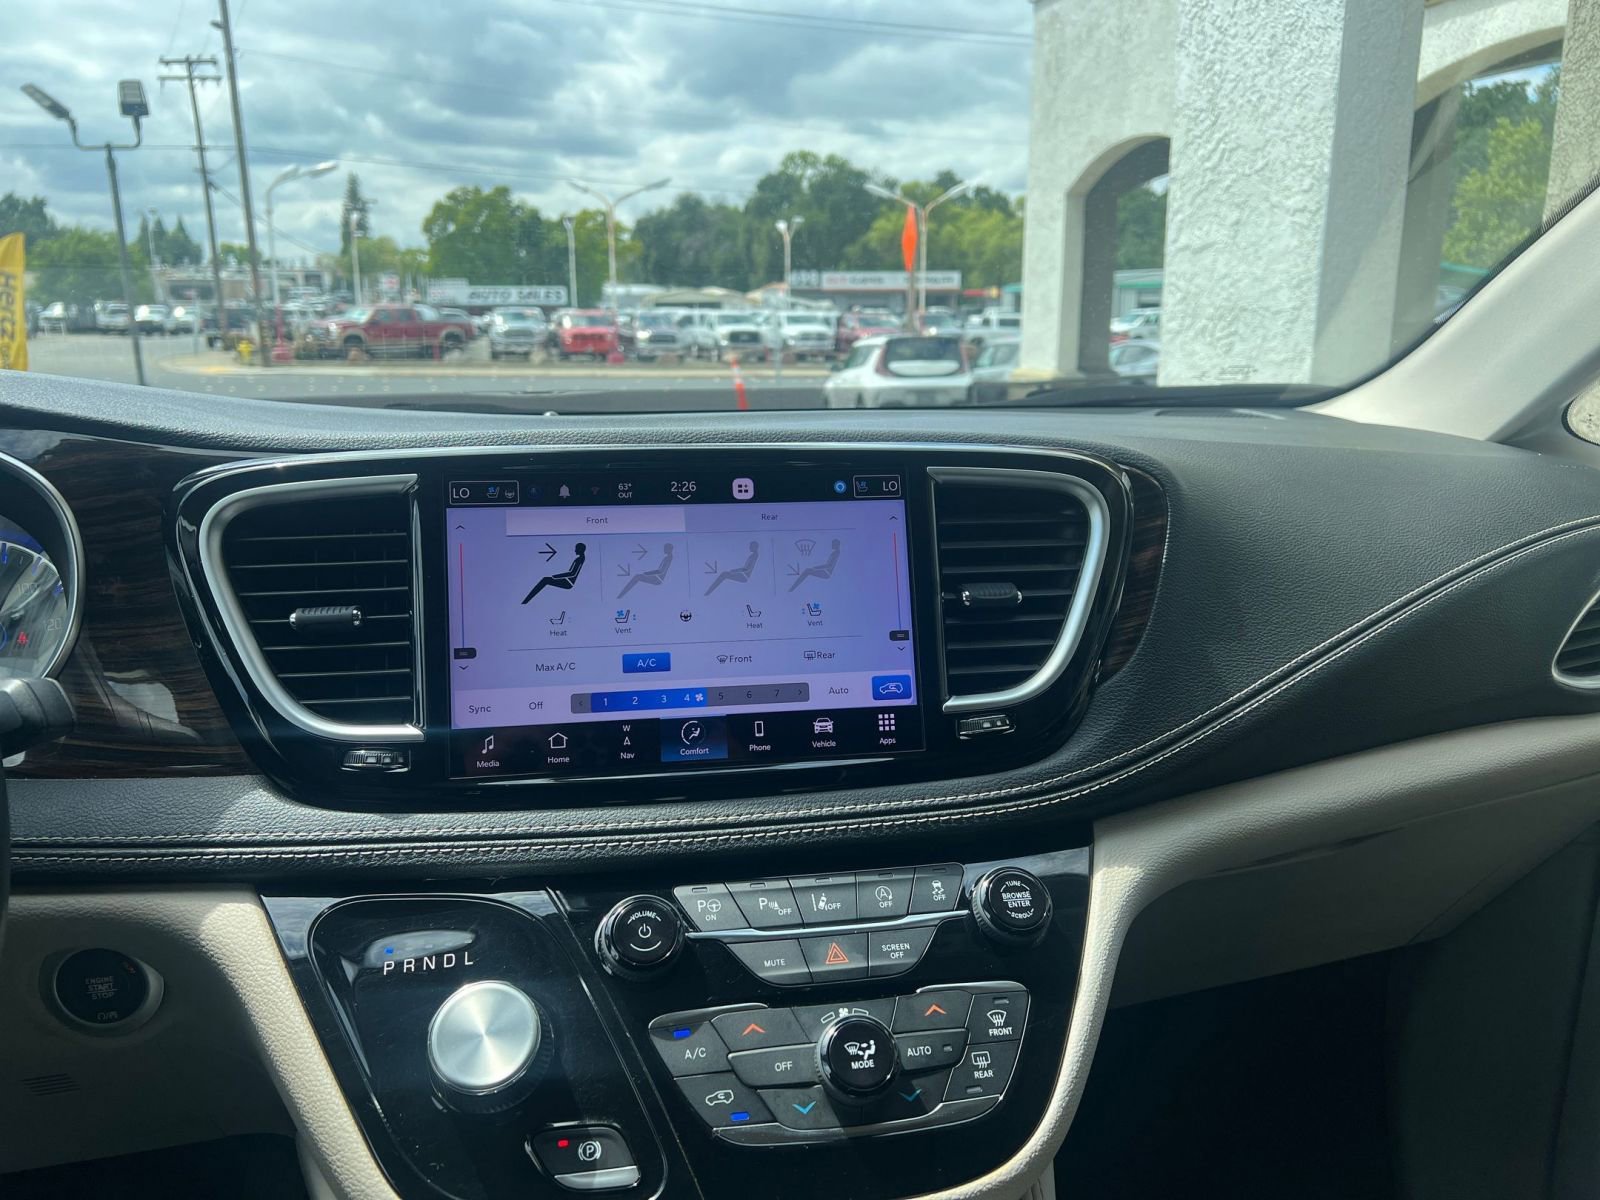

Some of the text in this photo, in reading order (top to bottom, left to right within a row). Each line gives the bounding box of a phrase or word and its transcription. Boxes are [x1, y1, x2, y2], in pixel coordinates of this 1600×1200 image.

[671, 481, 696, 492] 2:26
[883, 481, 898, 491] LO
[452, 487, 470, 499] LO
[586, 516, 608, 525] Front
[761, 513, 778, 521] Rear
[807, 619, 823, 627] Vent
[550, 629, 567, 637] Heat
[729, 654, 752, 663] Front
[816, 651, 836, 659] Rear
[535, 662, 576, 672] Max A/C
[637, 658, 657, 667] A/C
[828, 686, 849, 695] Auto
[632, 696, 639, 705] 2
[661, 695, 667, 703] 3
[683, 693, 690, 702] 4
[718, 692, 724, 700] 5
[746, 691, 752, 699] 6
[774, 689, 780, 697] 7
[468, 704, 491, 714] Sync
[528, 701, 544, 710] Off
[812, 740, 837, 748] Vehicle
[879, 737, 896, 746] Apps
[680, 747, 709, 756] Comfort
[749, 744, 771, 752] Phone
[620, 751, 635, 759] Nav
[476, 759, 500, 768] Media
[547, 756, 570, 764] Home
[1005, 880, 1022, 888] TUNE
[1001, 890, 1031, 900] BROWSE
[827, 902, 841, 910] OFF
[879, 900, 893, 908] OFF
[1007, 900, 1031, 908] ENTER
[630, 911, 657, 921] VOLUME
[777, 907, 792, 916] OFF
[1010, 910, 1033, 919] SCROLL
[881, 942, 910, 951] SCREEN
[890, 951, 904, 959] OFF
[764, 958, 786, 967] MUTE
[989, 1027, 1013, 1037] FRONT
[684, 1047, 707, 1060] A/C
[907, 1046, 932, 1057] AUTO
[774, 1061, 793, 1072] OFF
[851, 1060, 875, 1070] MODE
[974, 1069, 994, 1079] REAR
